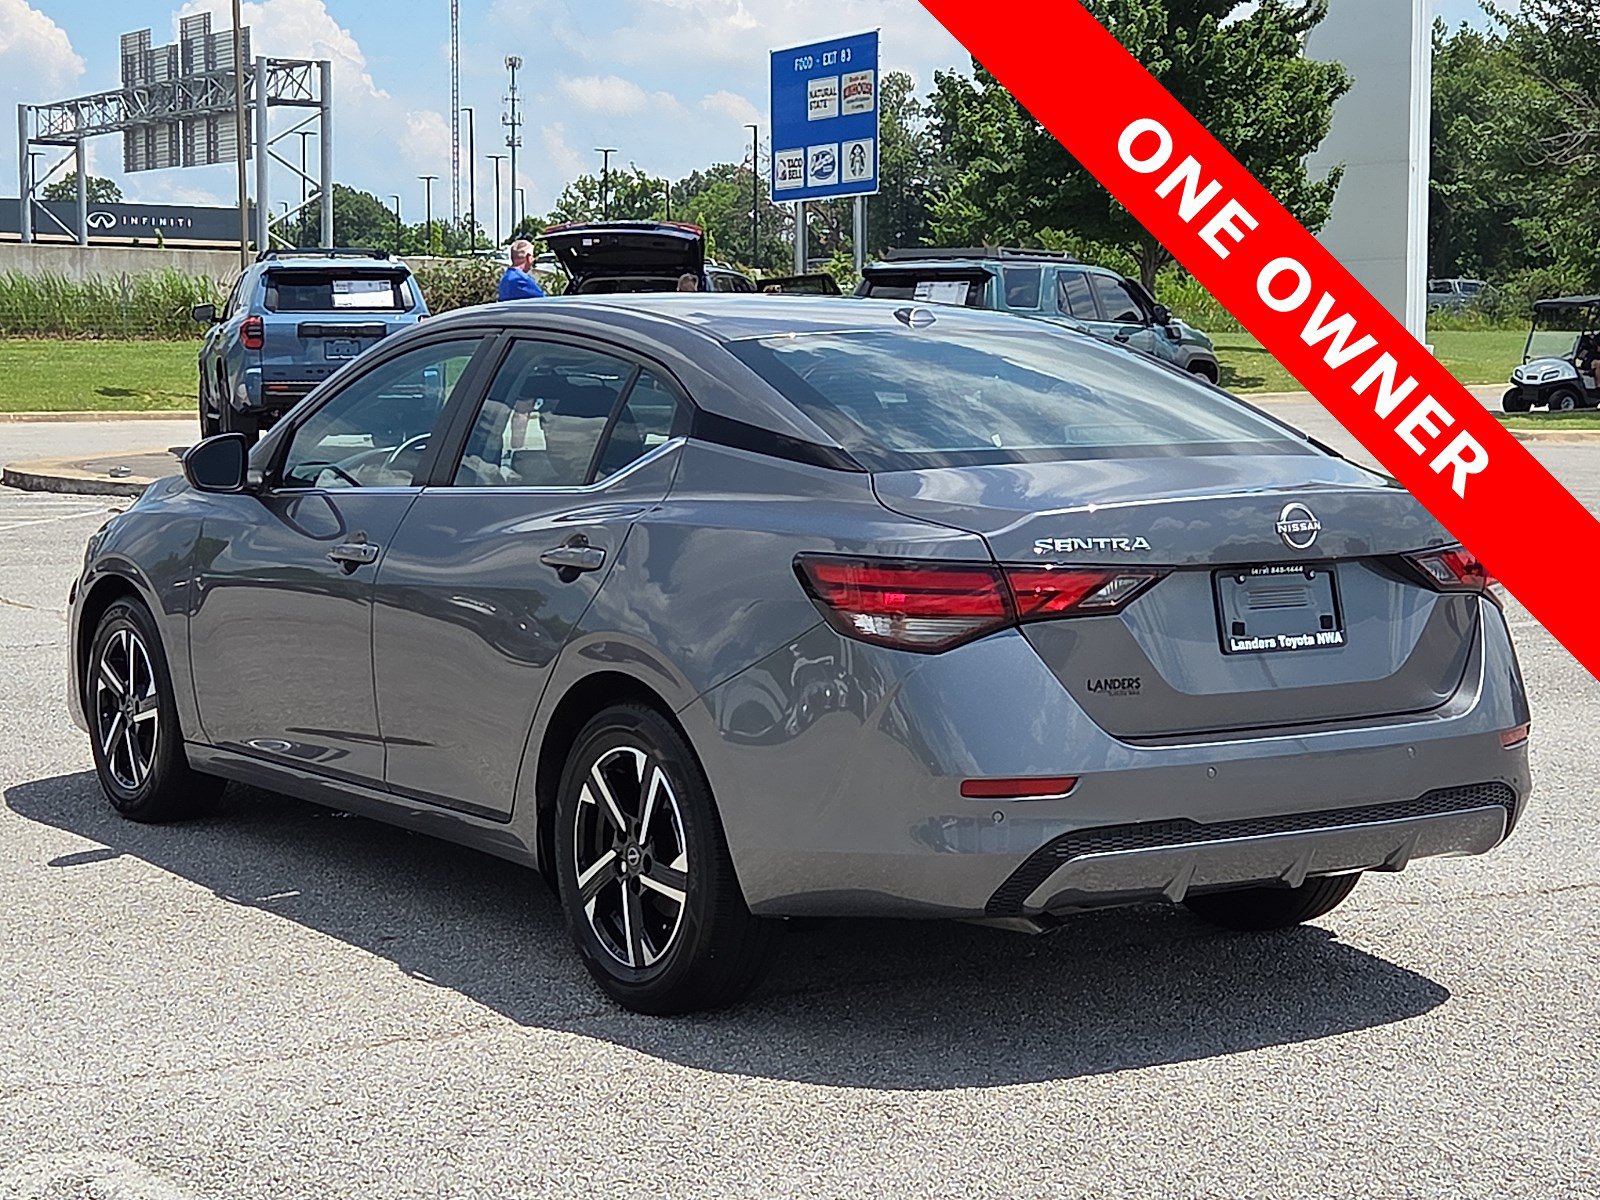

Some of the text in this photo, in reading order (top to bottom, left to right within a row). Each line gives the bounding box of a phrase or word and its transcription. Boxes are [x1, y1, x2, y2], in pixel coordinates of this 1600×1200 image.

[795, 56, 813, 71] FOOD
[823, 51, 837, 66] EXIT
[841, 48, 851, 63] 83
[809, 86, 837, 98] NATURAL
[809, 99, 827, 110] STATE
[787, 158, 803, 168] TACO
[788, 168, 802, 180] BELL
[121, 216, 192, 228] INFINITI
[1276, 520, 1322, 533] NISSAN
[1033, 536, 1152, 554] SENTRA
[1230, 631, 1344, 651] Landers Toyota NWA
[1087, 677, 1141, 692] LANDERS
